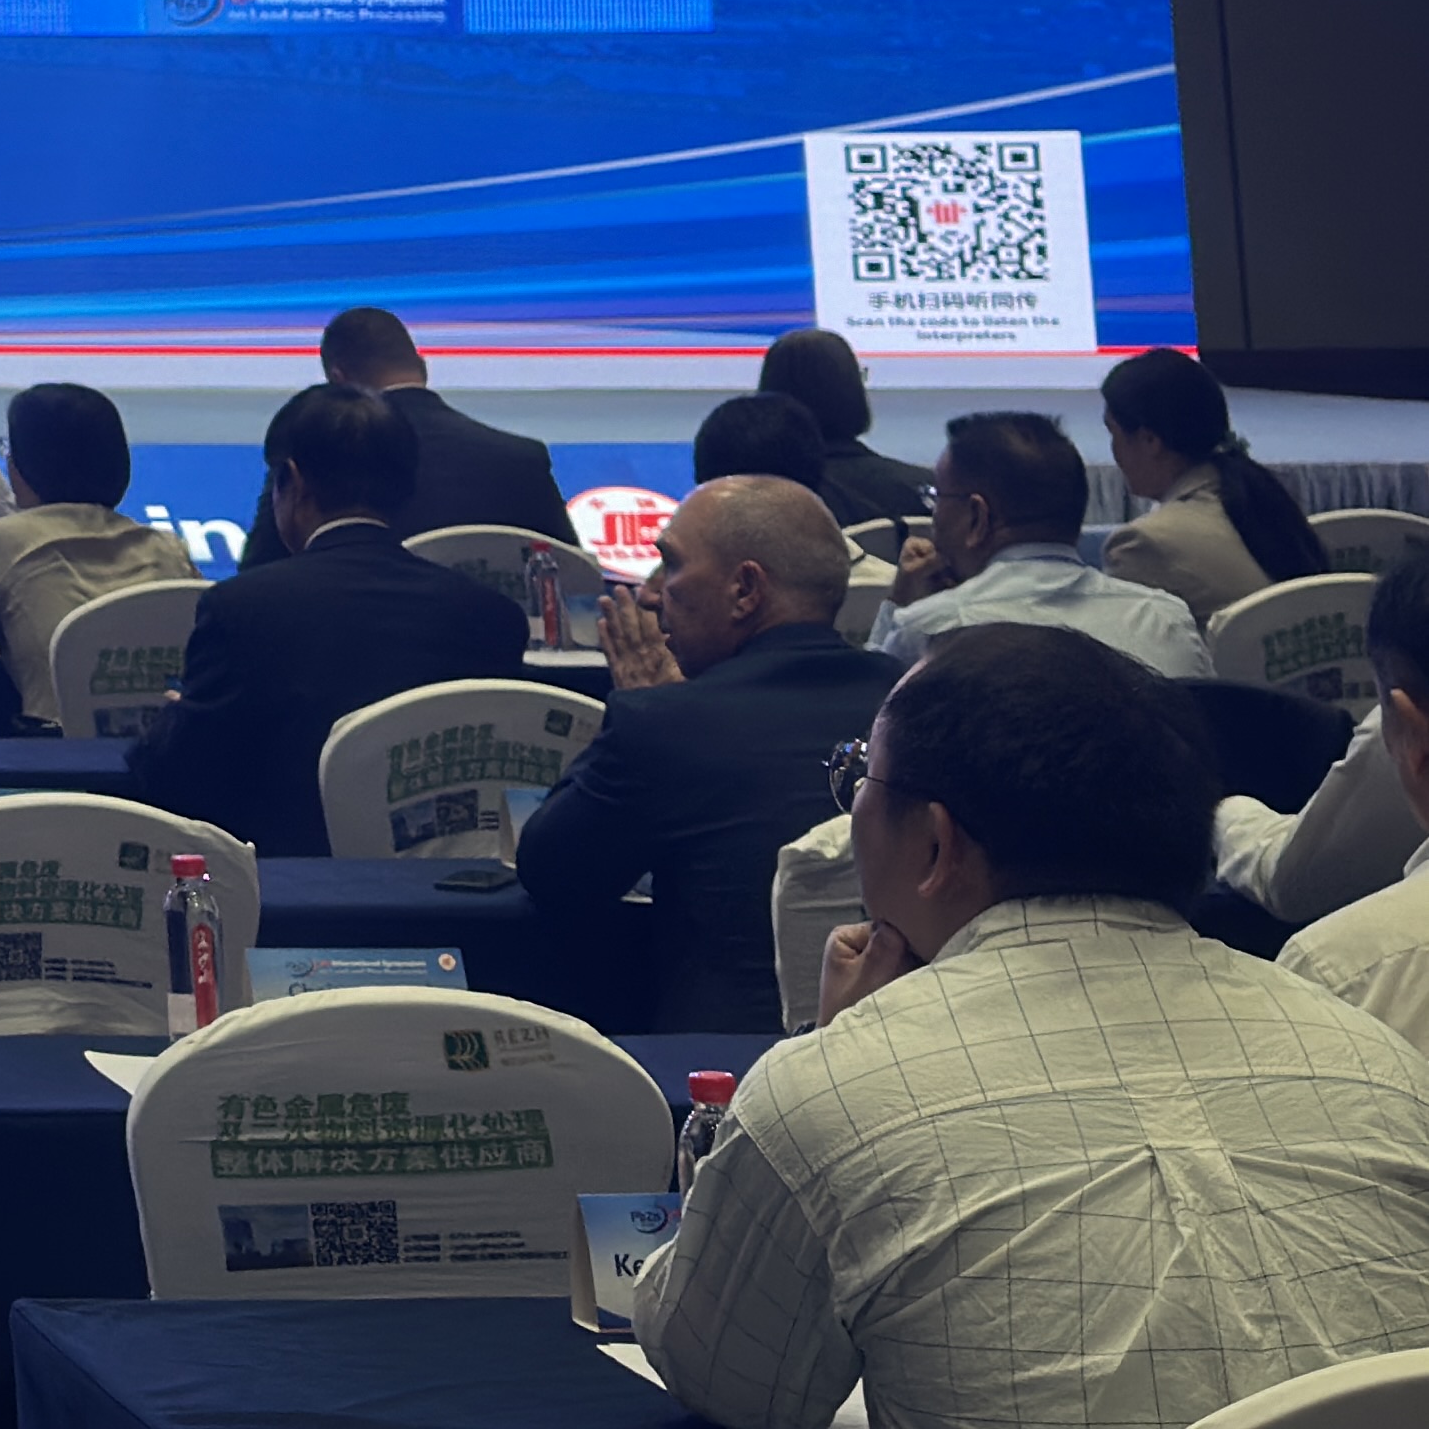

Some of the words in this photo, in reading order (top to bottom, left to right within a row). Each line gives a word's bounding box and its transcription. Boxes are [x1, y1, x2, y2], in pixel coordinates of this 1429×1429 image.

[215, 1141, 549, 1175] 整体解决方案供应商
